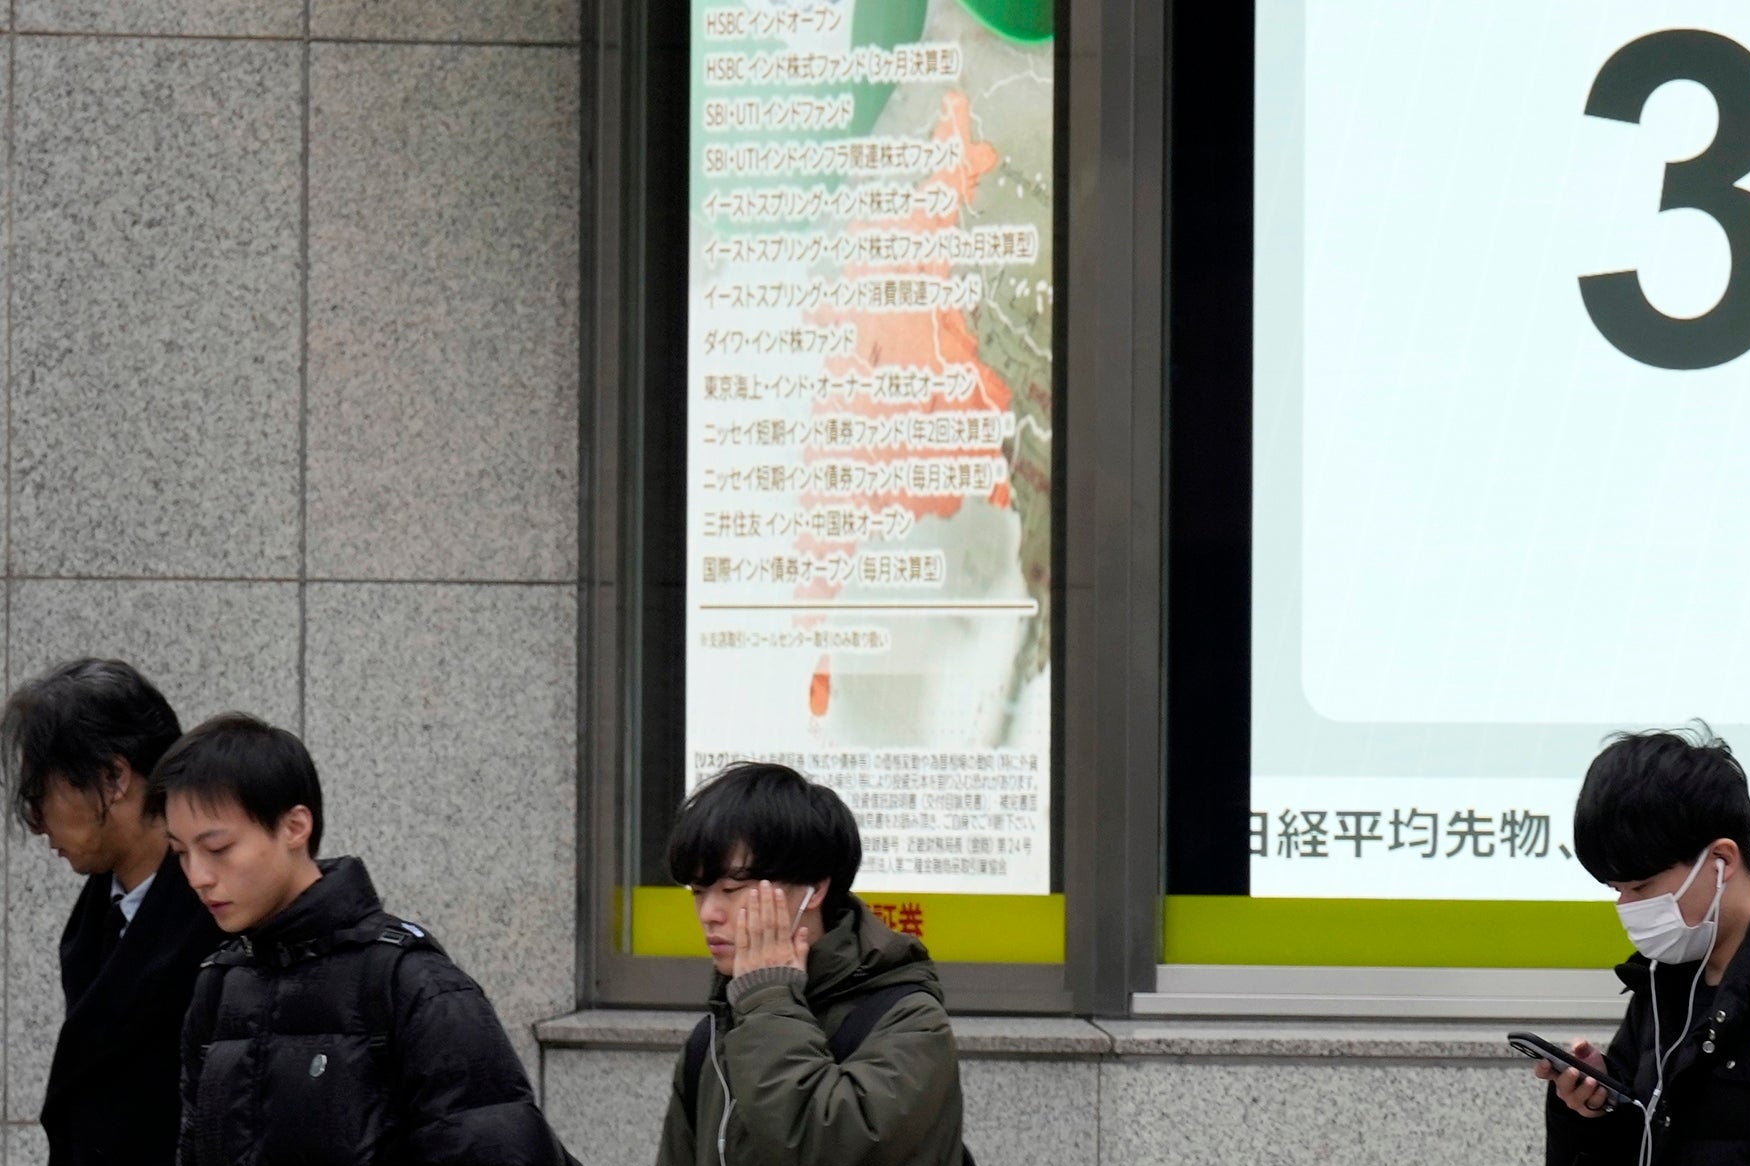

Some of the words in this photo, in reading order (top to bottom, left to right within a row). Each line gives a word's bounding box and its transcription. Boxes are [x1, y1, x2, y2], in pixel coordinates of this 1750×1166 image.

[706, 17, 744, 36] HSBC
[748, 8, 842, 34] インドオープン
[706, 60, 744, 81] HSBC
[762, 100, 851, 125] インドファンド
[704, 186, 955, 218] イーストスプリング・インド株式オープン
[703, 329, 855, 356] ダイワ・インド株ファンド
[702, 512, 762, 538] 三井住友
[766, 509, 912, 536] インド・中国株オープン
